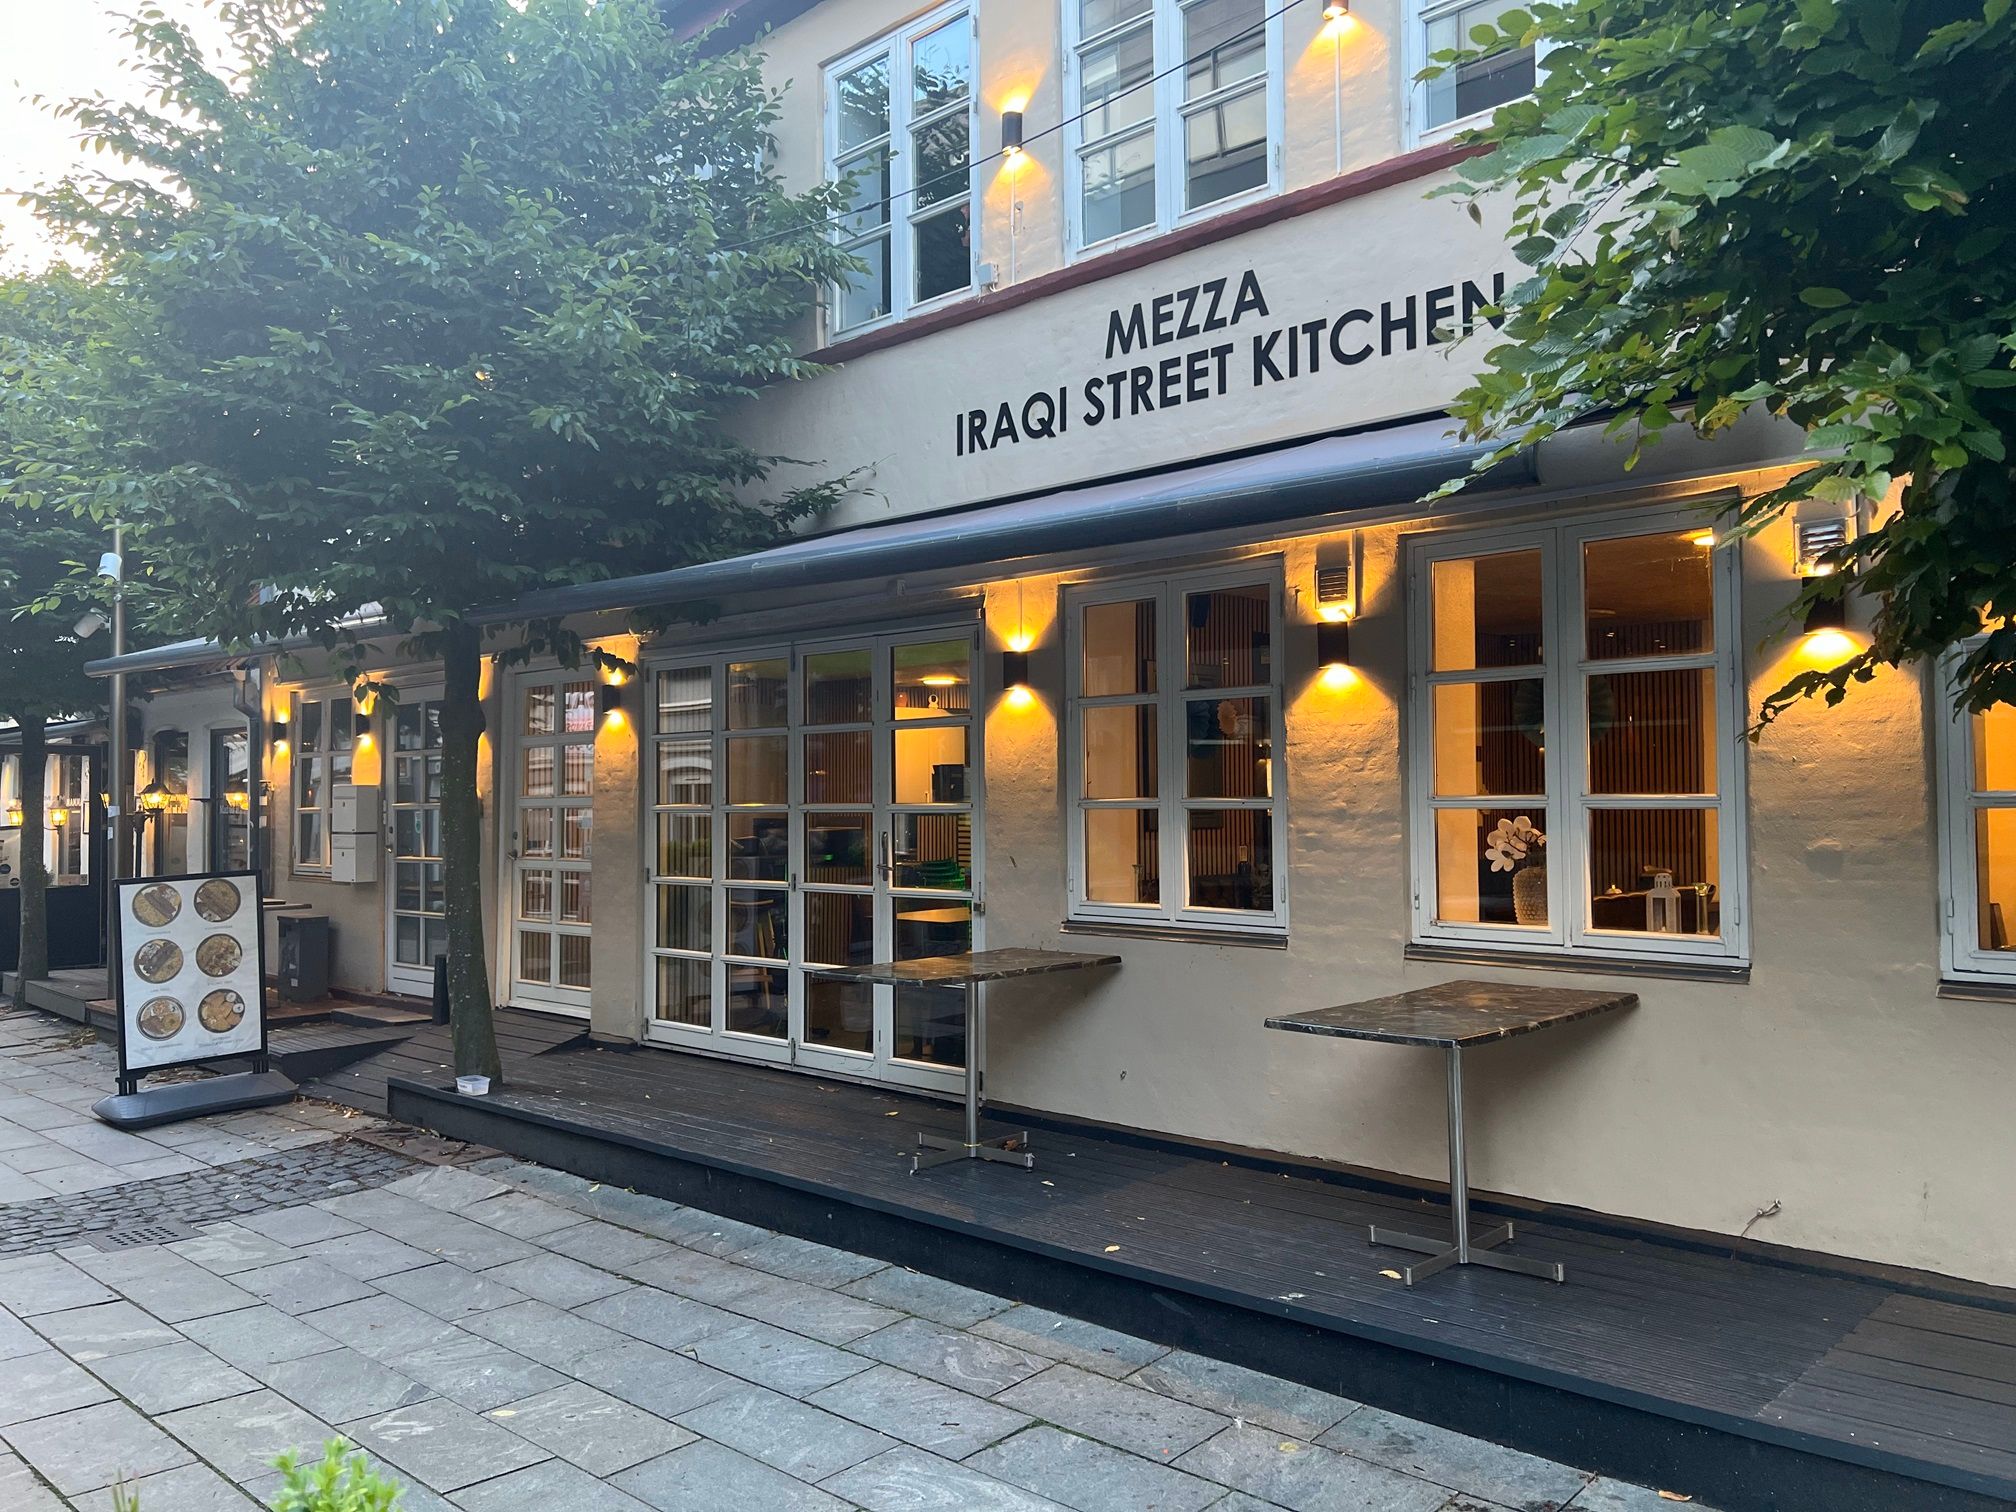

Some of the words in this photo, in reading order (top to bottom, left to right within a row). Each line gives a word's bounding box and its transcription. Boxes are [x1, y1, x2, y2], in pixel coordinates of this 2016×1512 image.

[956, 386, 1067, 457] IRAQI
[1083, 342, 1234, 427] STREET
[1253, 271, 1506, 387] KITCHEN
[1105, 269, 1270, 360] MEZZA
